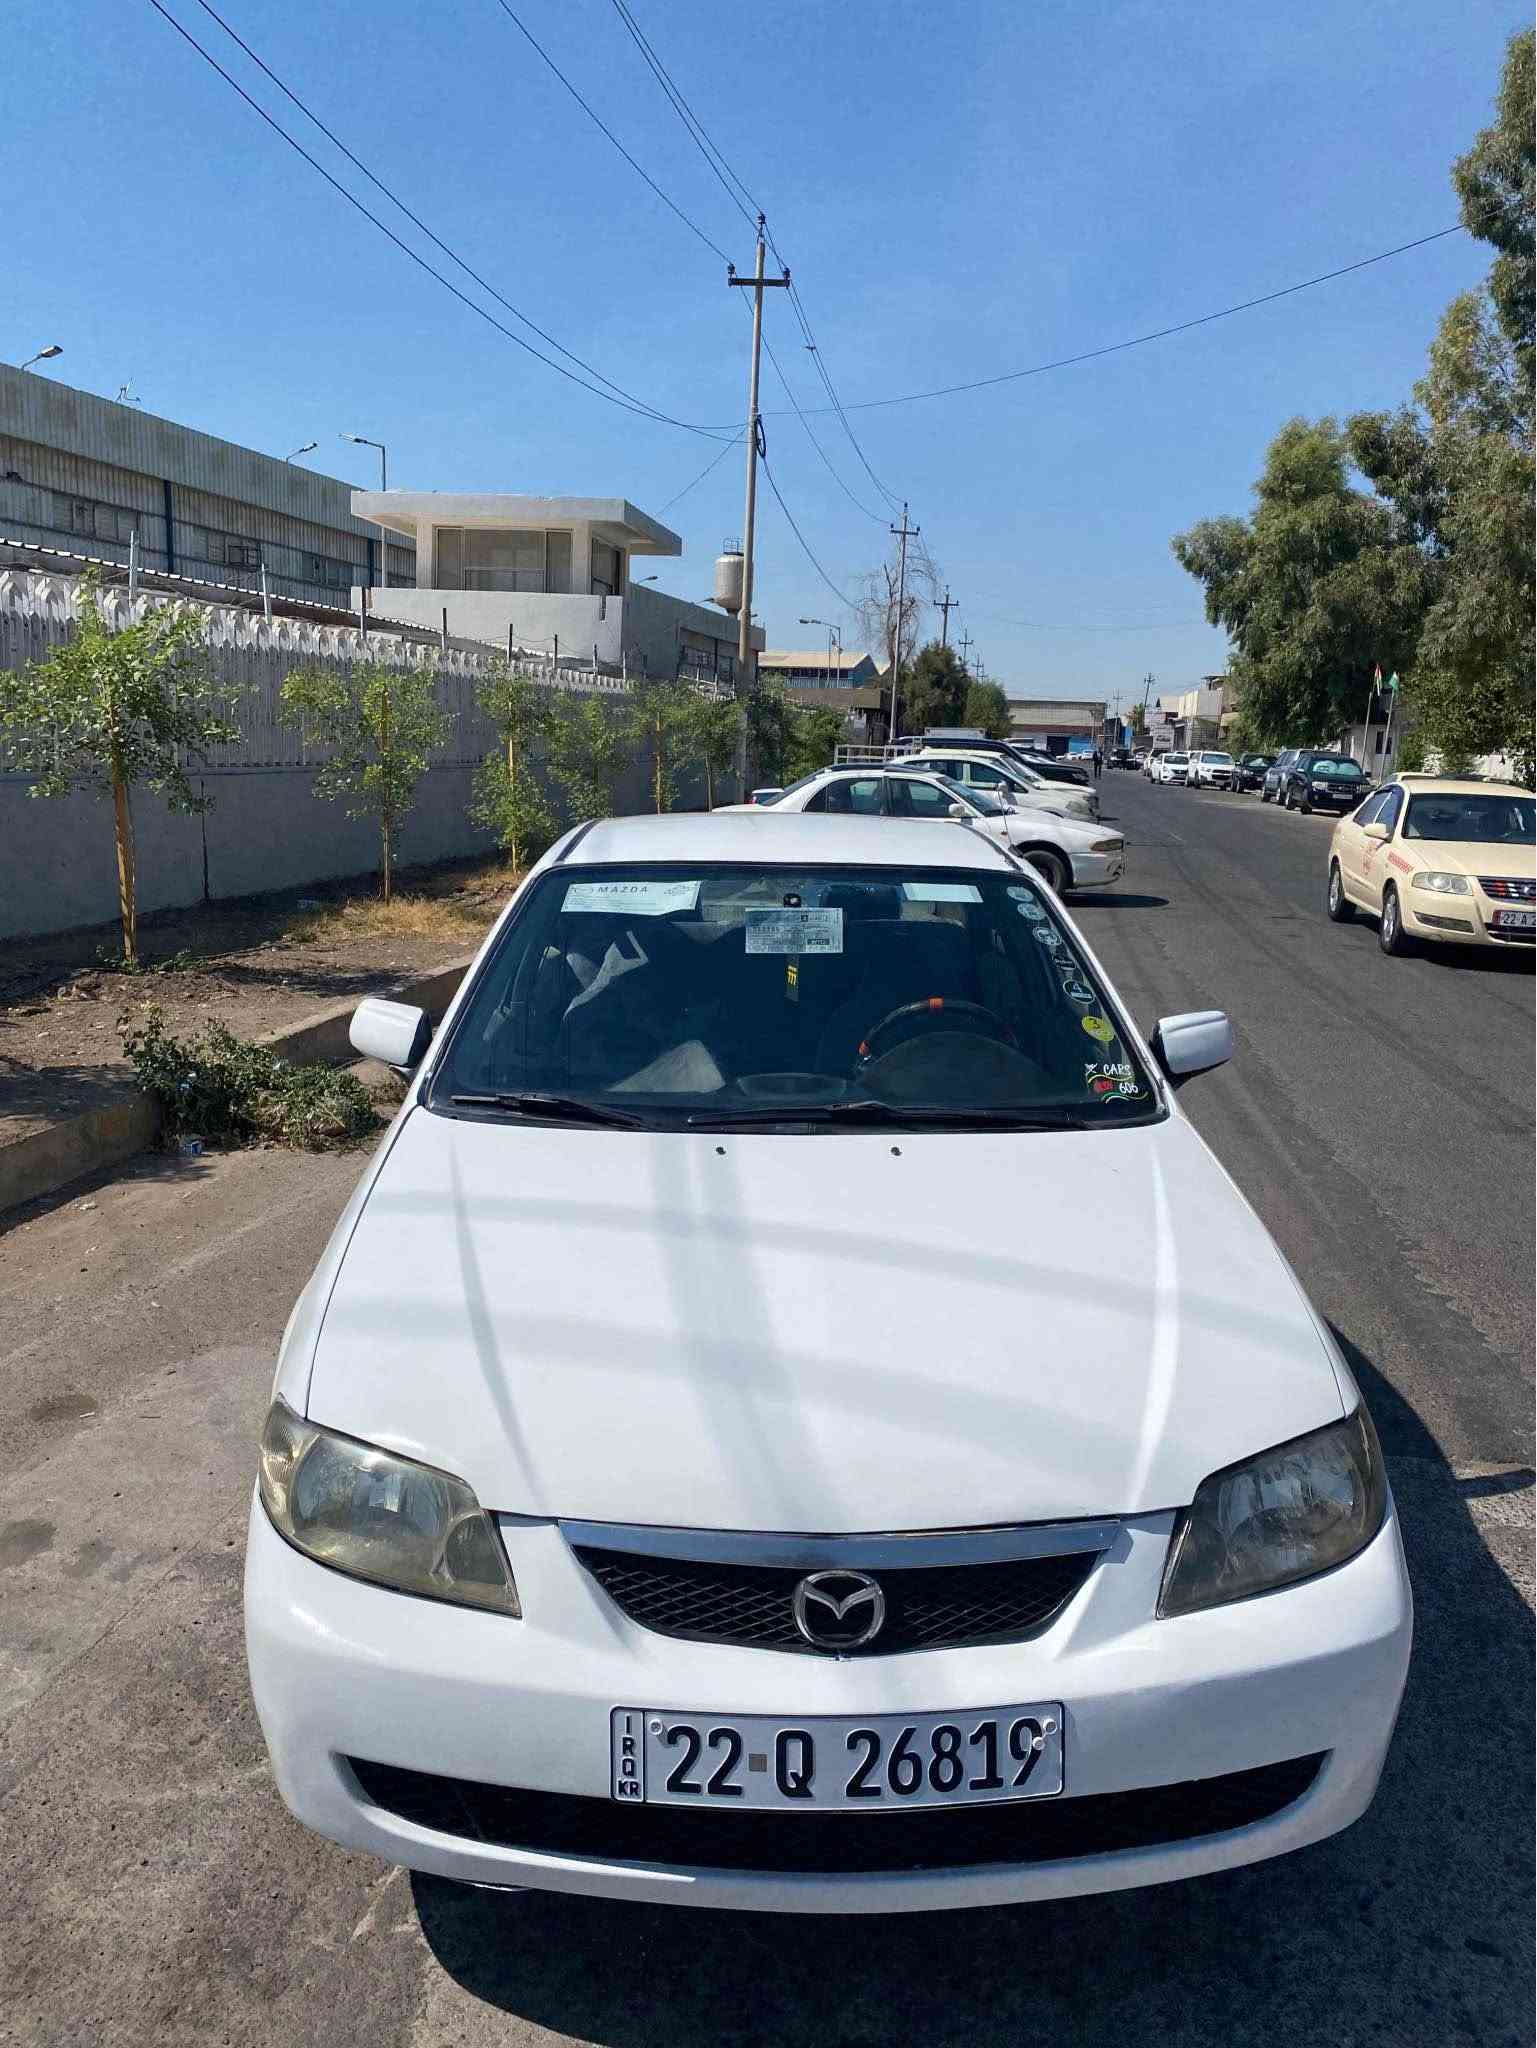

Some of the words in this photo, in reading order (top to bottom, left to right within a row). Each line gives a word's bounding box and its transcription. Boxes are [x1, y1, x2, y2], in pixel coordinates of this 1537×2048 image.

[1503, 913, 1516, 924] 22
[666, 1724, 744, 1796] 22
[775, 1729, 814, 1799] Q
[846, 1717, 1043, 1797] 26819
[617, 1779, 640, 1796] KR
